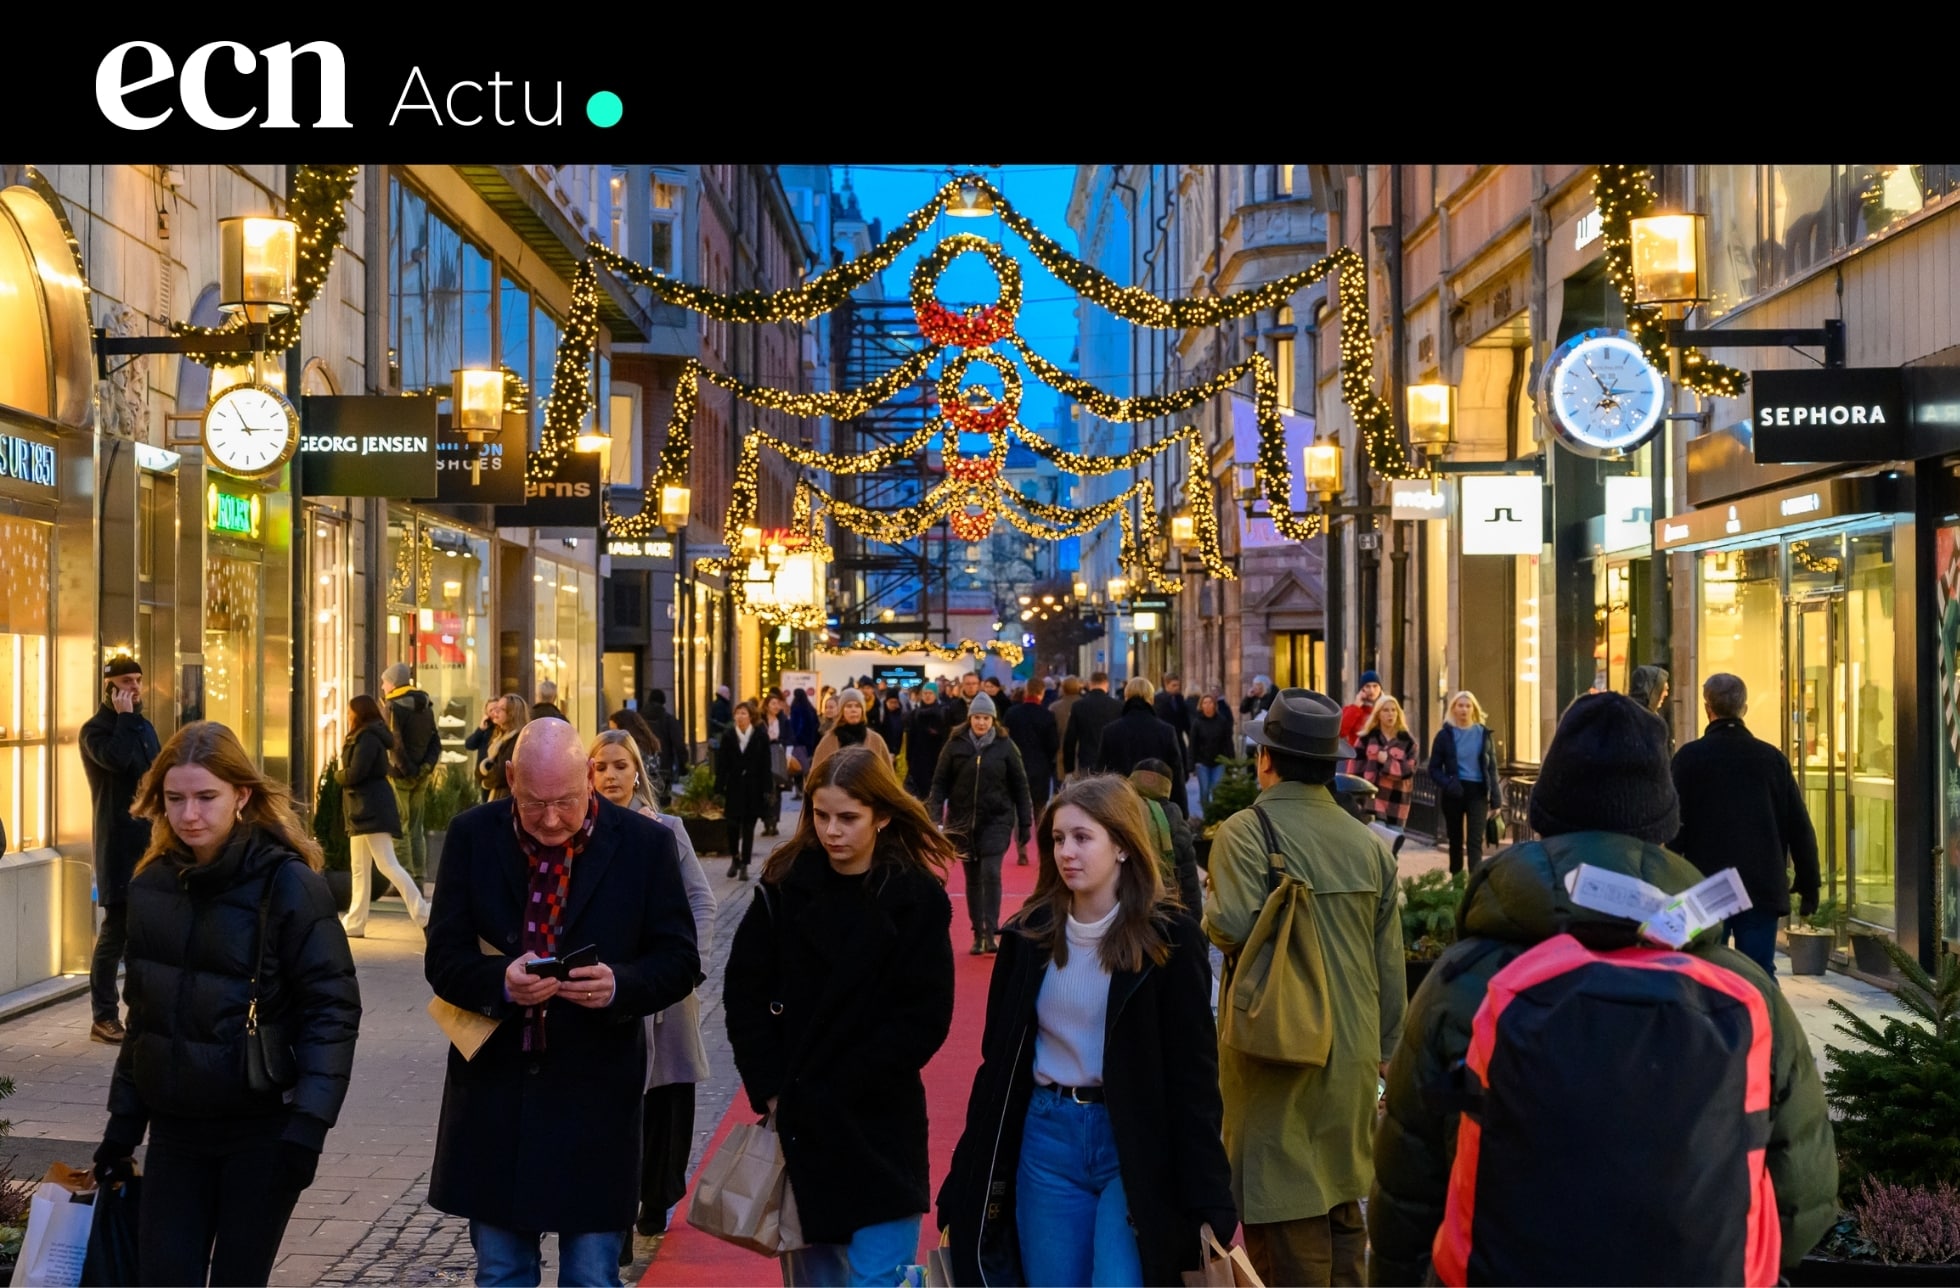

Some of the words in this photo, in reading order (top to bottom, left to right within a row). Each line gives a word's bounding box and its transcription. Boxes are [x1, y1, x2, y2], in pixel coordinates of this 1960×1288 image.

[1760, 405, 1887, 427] SEPHORA
[361, 436, 428, 456] JENSEN
[525, 481, 592, 498] erns
[217, 492, 252, 533] ROLEX
